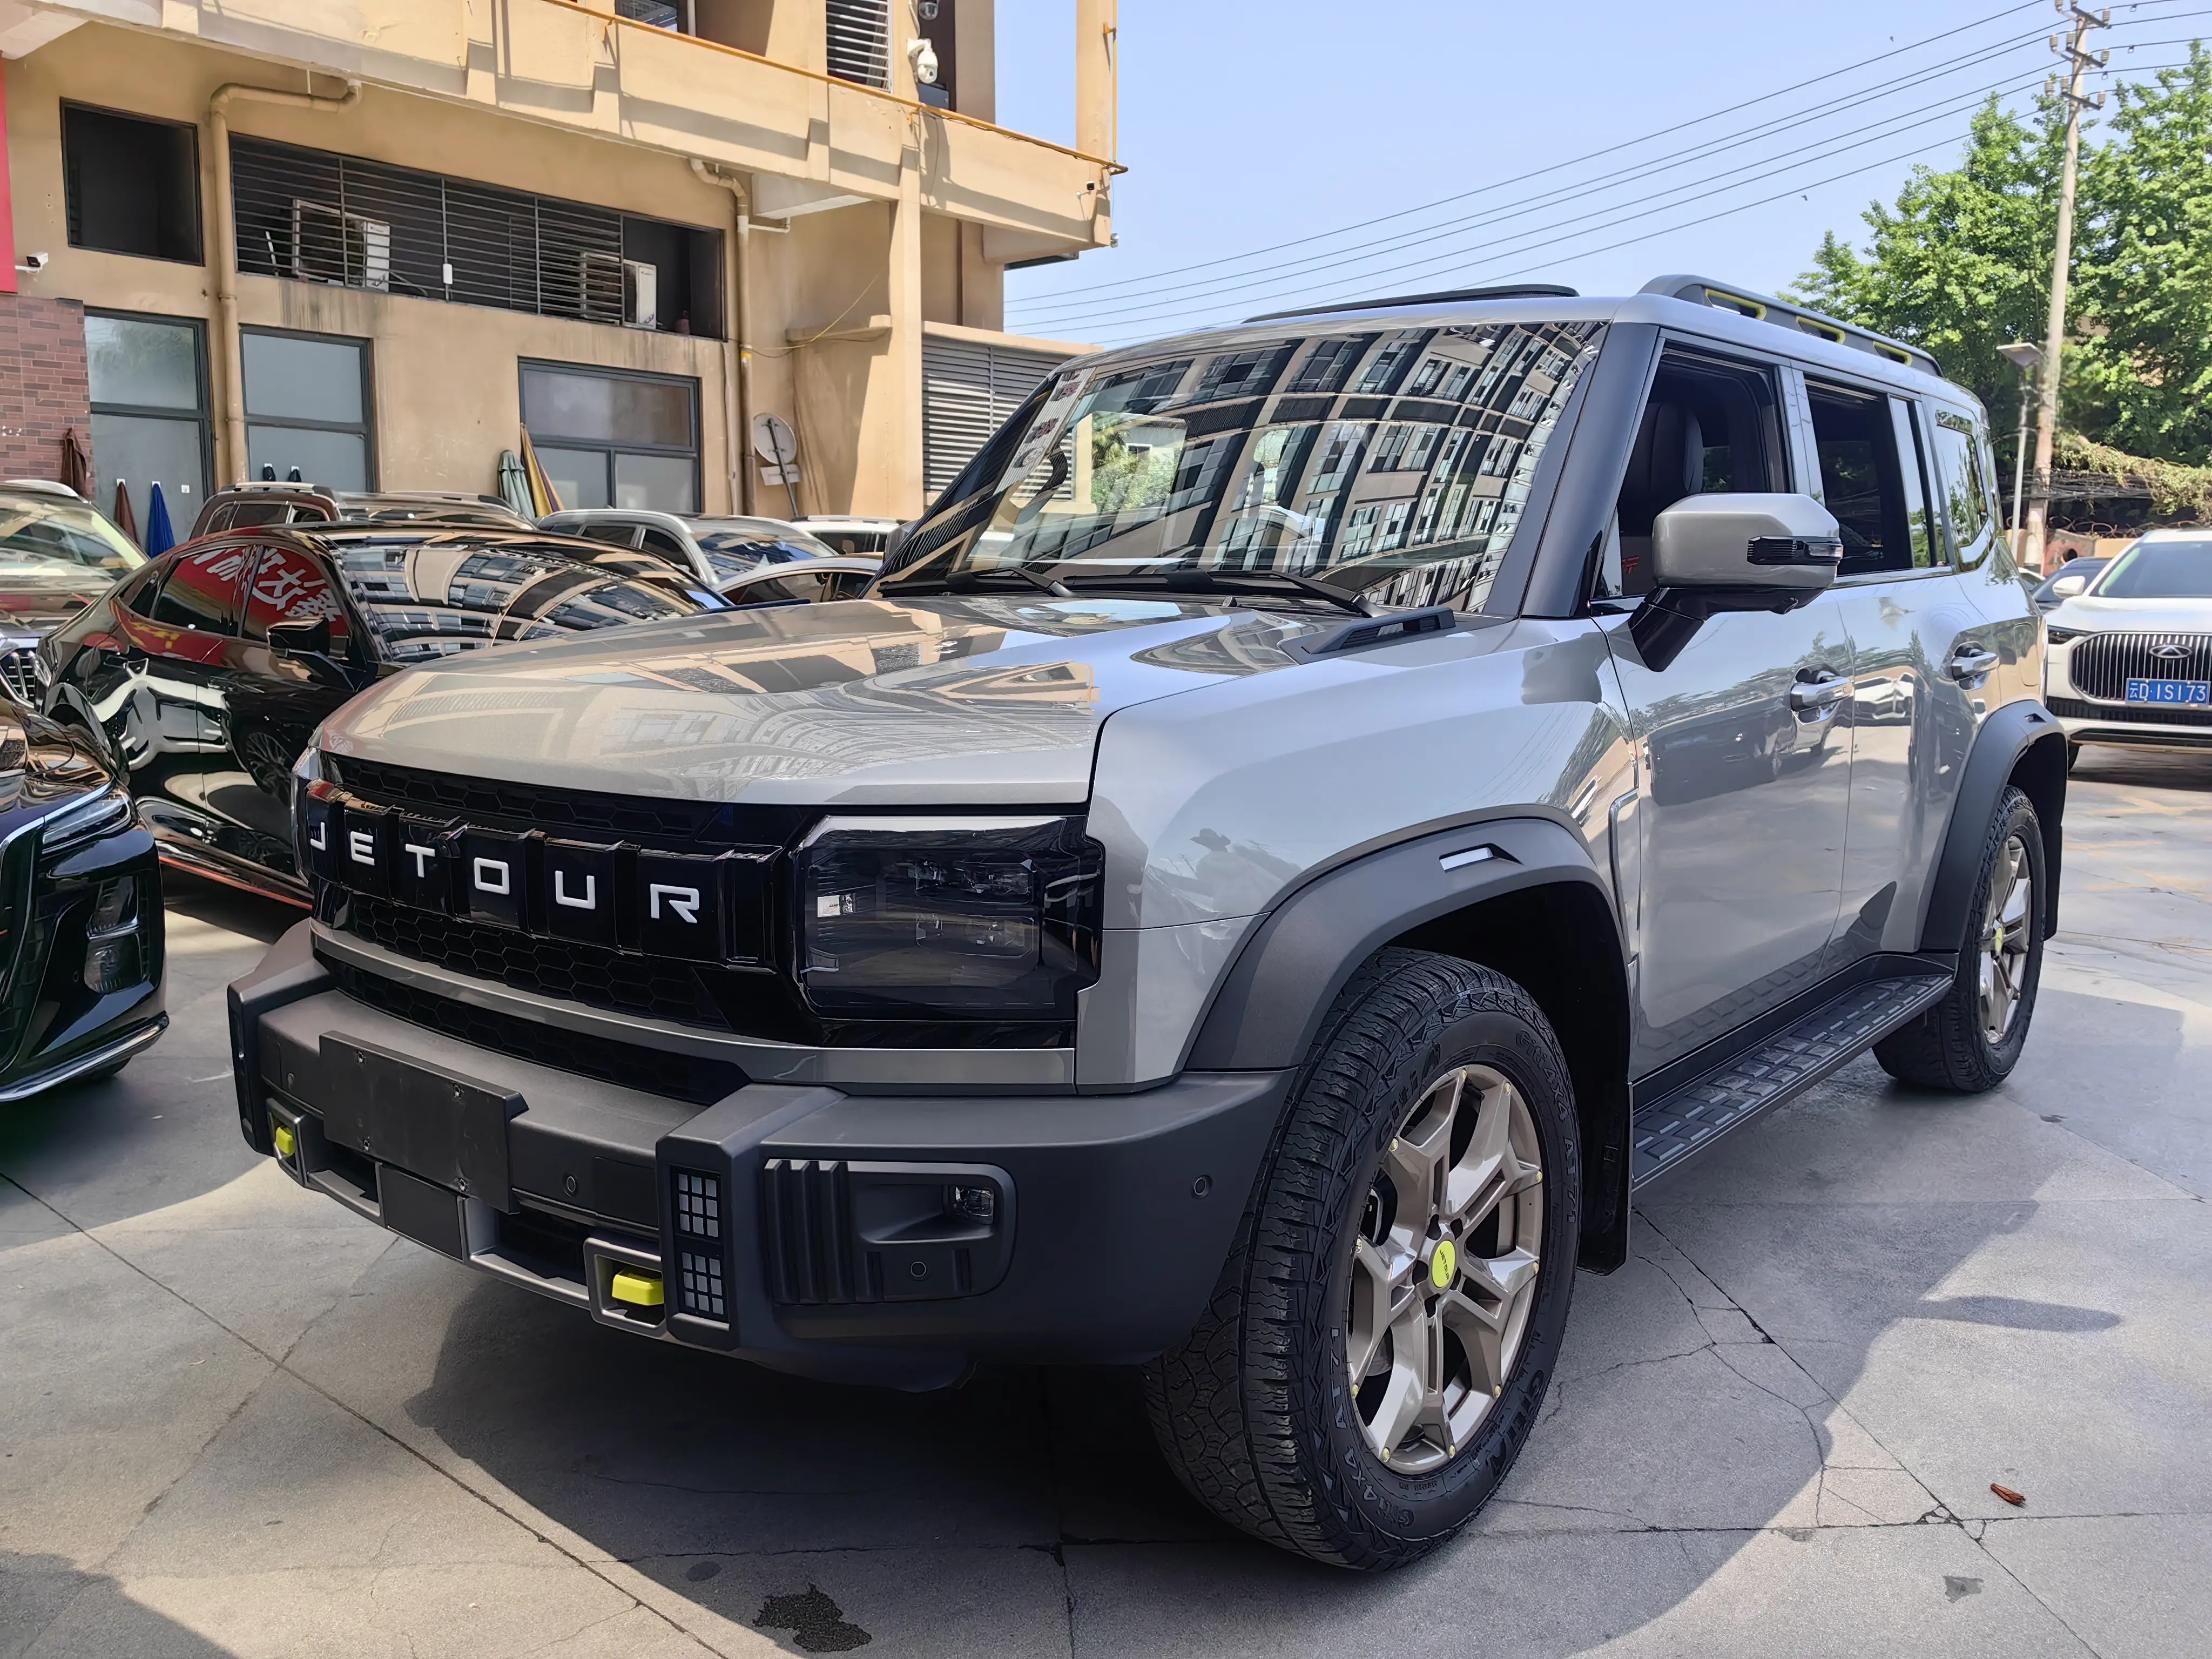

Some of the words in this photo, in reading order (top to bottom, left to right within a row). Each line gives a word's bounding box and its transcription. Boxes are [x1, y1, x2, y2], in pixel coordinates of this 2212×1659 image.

[310, 822, 700, 923] JETOUR
[1563, 1136, 1578, 1223] AT71
[1439, 1249, 1449, 1280] JETOUR
[1329, 1326, 1348, 1429] AT71
